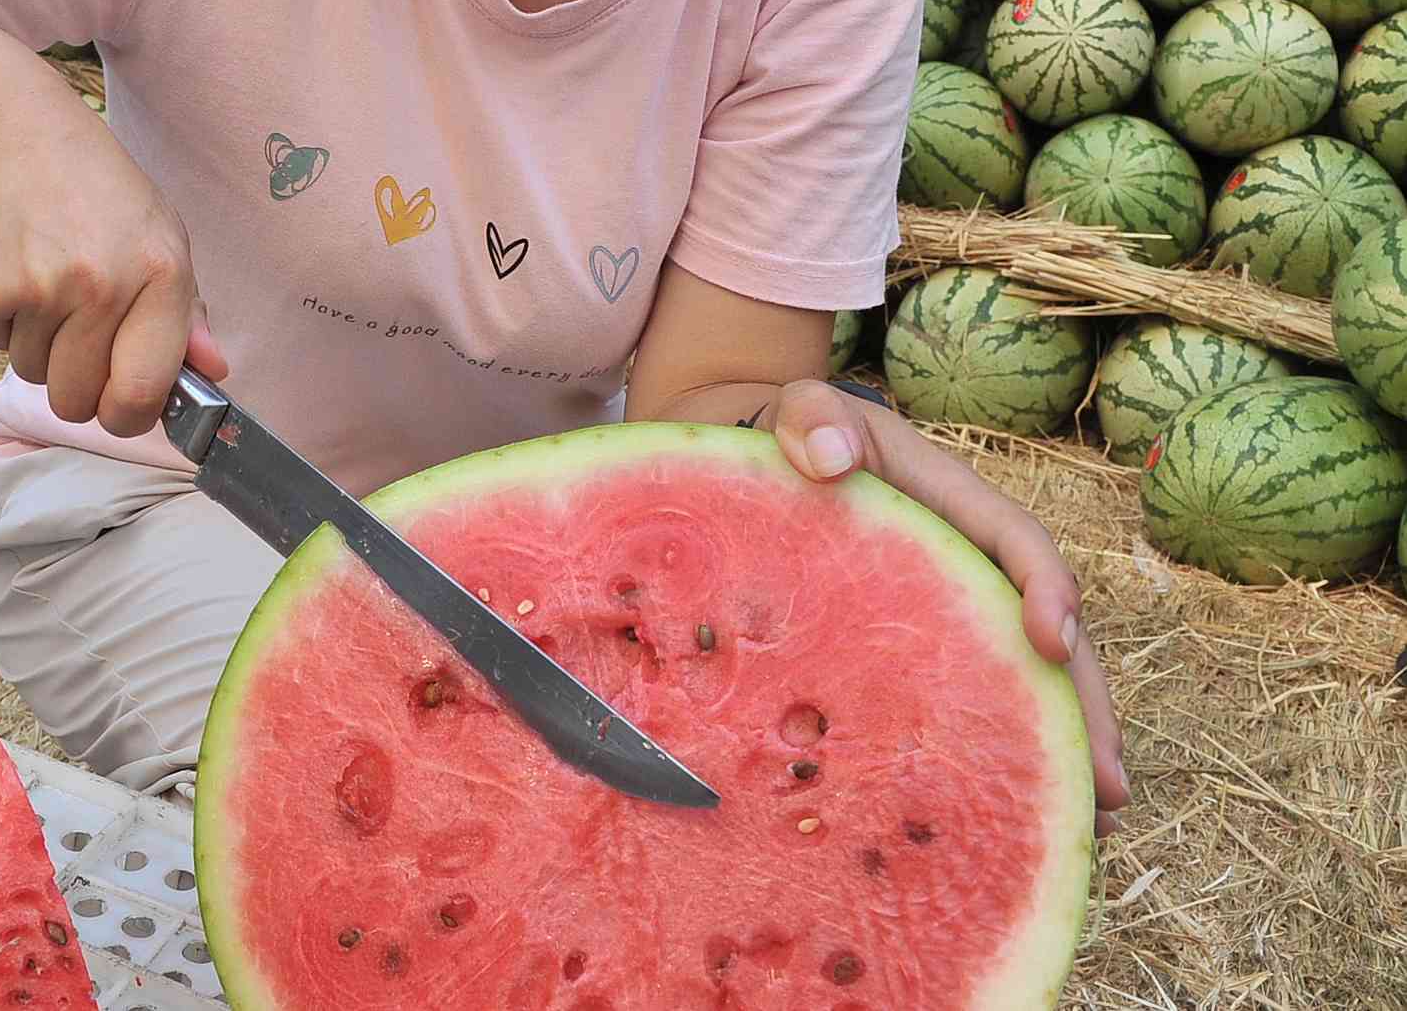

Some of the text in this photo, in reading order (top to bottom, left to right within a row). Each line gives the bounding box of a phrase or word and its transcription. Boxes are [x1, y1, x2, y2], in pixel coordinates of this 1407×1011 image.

[302, 297, 356, 323] Have
[385, 321, 440, 338] good
[501, 367, 573, 383] every
